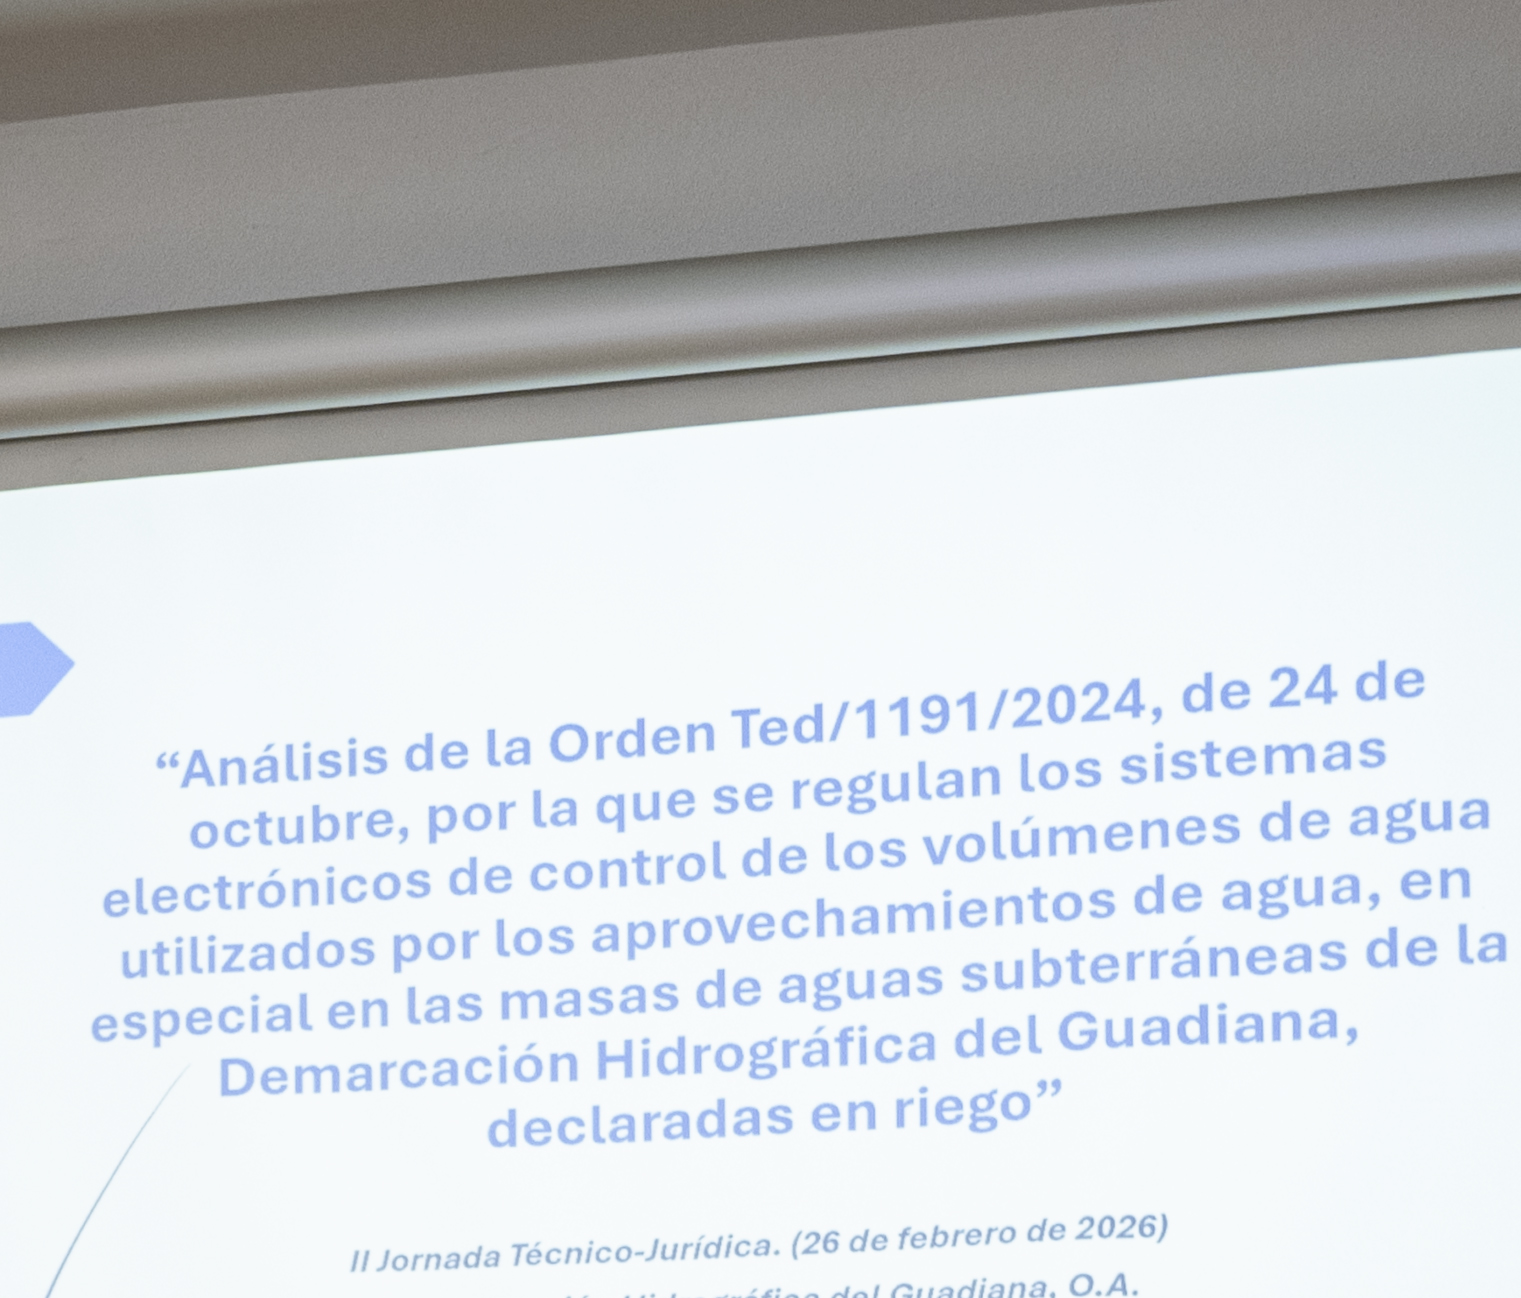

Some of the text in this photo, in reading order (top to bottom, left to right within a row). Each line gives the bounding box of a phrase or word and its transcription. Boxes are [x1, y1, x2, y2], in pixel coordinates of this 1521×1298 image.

[156, 660, 1424, 788] “Análisis de la Orden Ted/1191/2024, de 24 de
[190, 738, 1386, 849] octubre, por la que se regulan los sistemas
[103, 799, 1489, 917] electrónicos de control de los volúmenes de agua
[122, 868, 1470, 979] utilizados por los aprovechamientos de agua, en
[92, 924, 1506, 1048] especial en las masas de aguas subterráneas de la
[221, 1003, 1357, 1096] Demarcación Hidrográfica del Guadiana,
[488, 1079, 1061, 1147] declaradas en riego”
